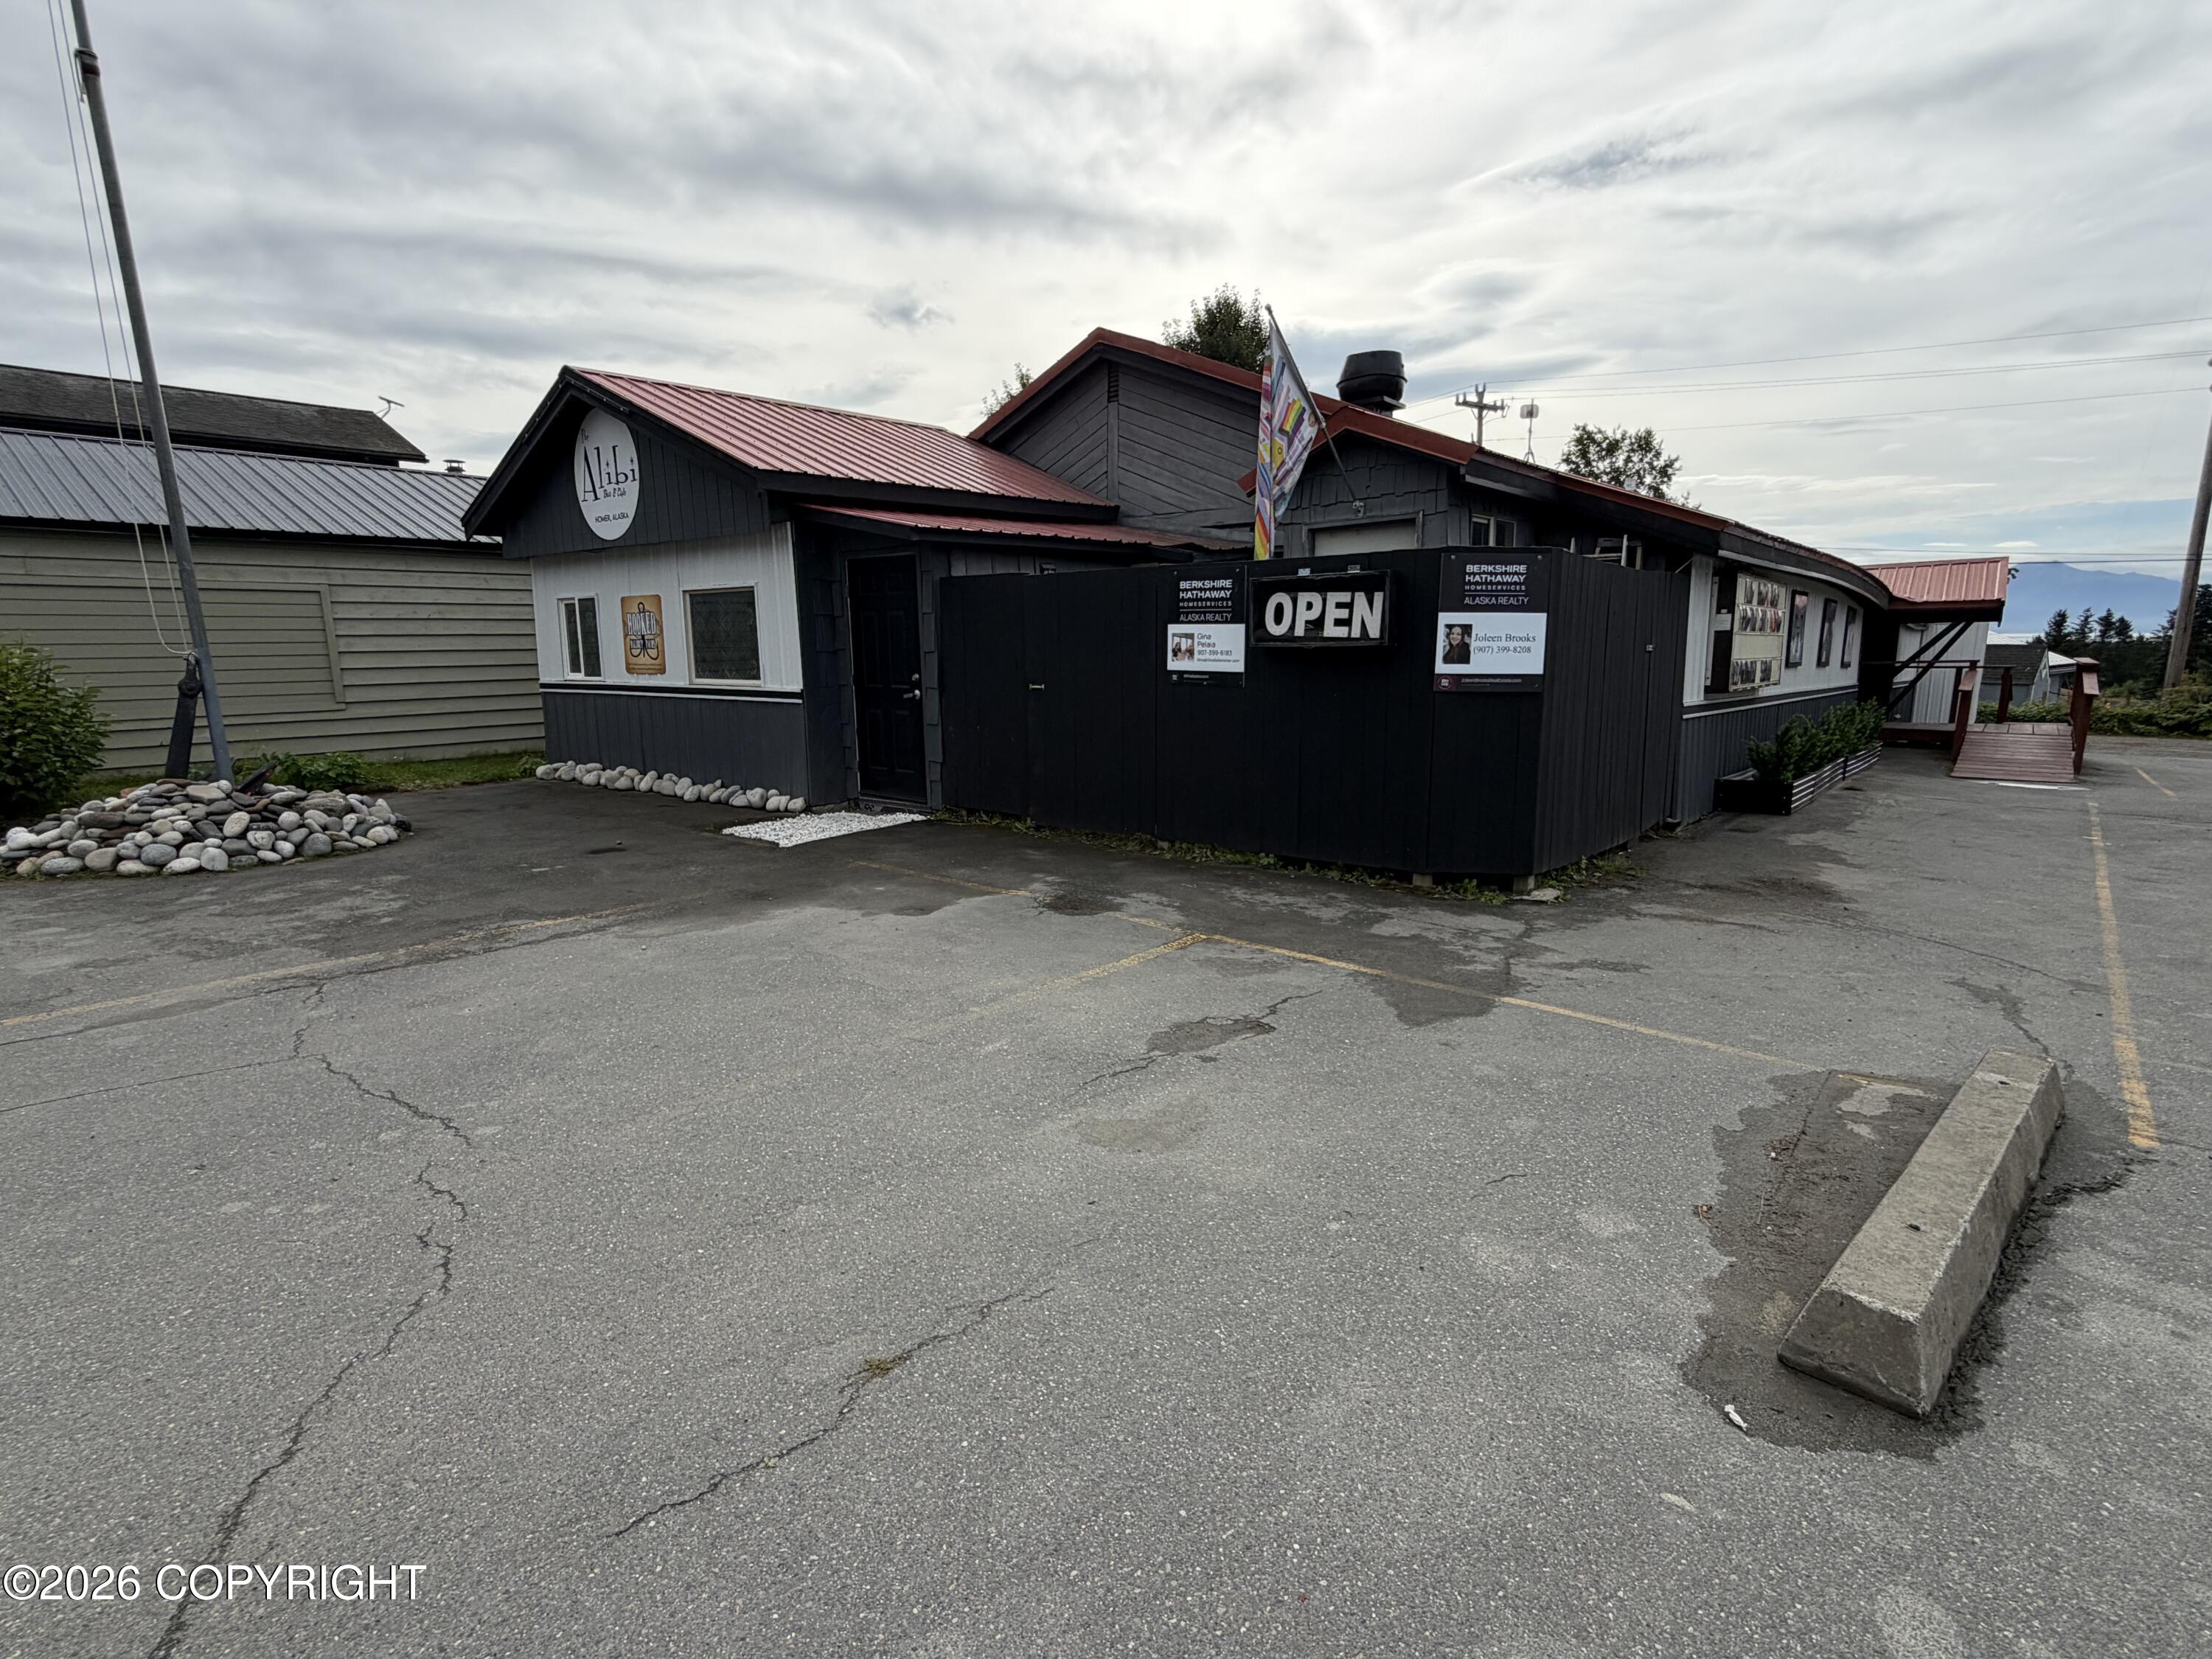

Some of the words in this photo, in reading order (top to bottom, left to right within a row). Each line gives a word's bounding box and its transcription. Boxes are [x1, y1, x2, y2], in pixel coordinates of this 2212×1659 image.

[581, 445, 638, 502] Alibi
[612, 512, 630, 521] ALASKA
[1466, 565, 1528, 573] BERKSHIRE
[1465, 574, 1527, 582] HATHAWAY
[1180, 580, 1233, 589] BERKSHIRE
[1180, 590, 1232, 599] HATHAWAY
[1464, 597, 1497, 605] ALASKA
[1498, 597, 1529, 605] REALTY
[1180, 613, 1205, 622] ALASKA
[1206, 613, 1233, 622] REALTY
[1265, 591, 1384, 639] OPEN
[627, 612, 656, 635] HOOKED
[1473, 633, 1502, 642] Joleen
[1505, 633, 1537, 642] Brooks
[1473, 645, 1494, 655] (907)
[1496, 646, 1531, 654] 399-8208
